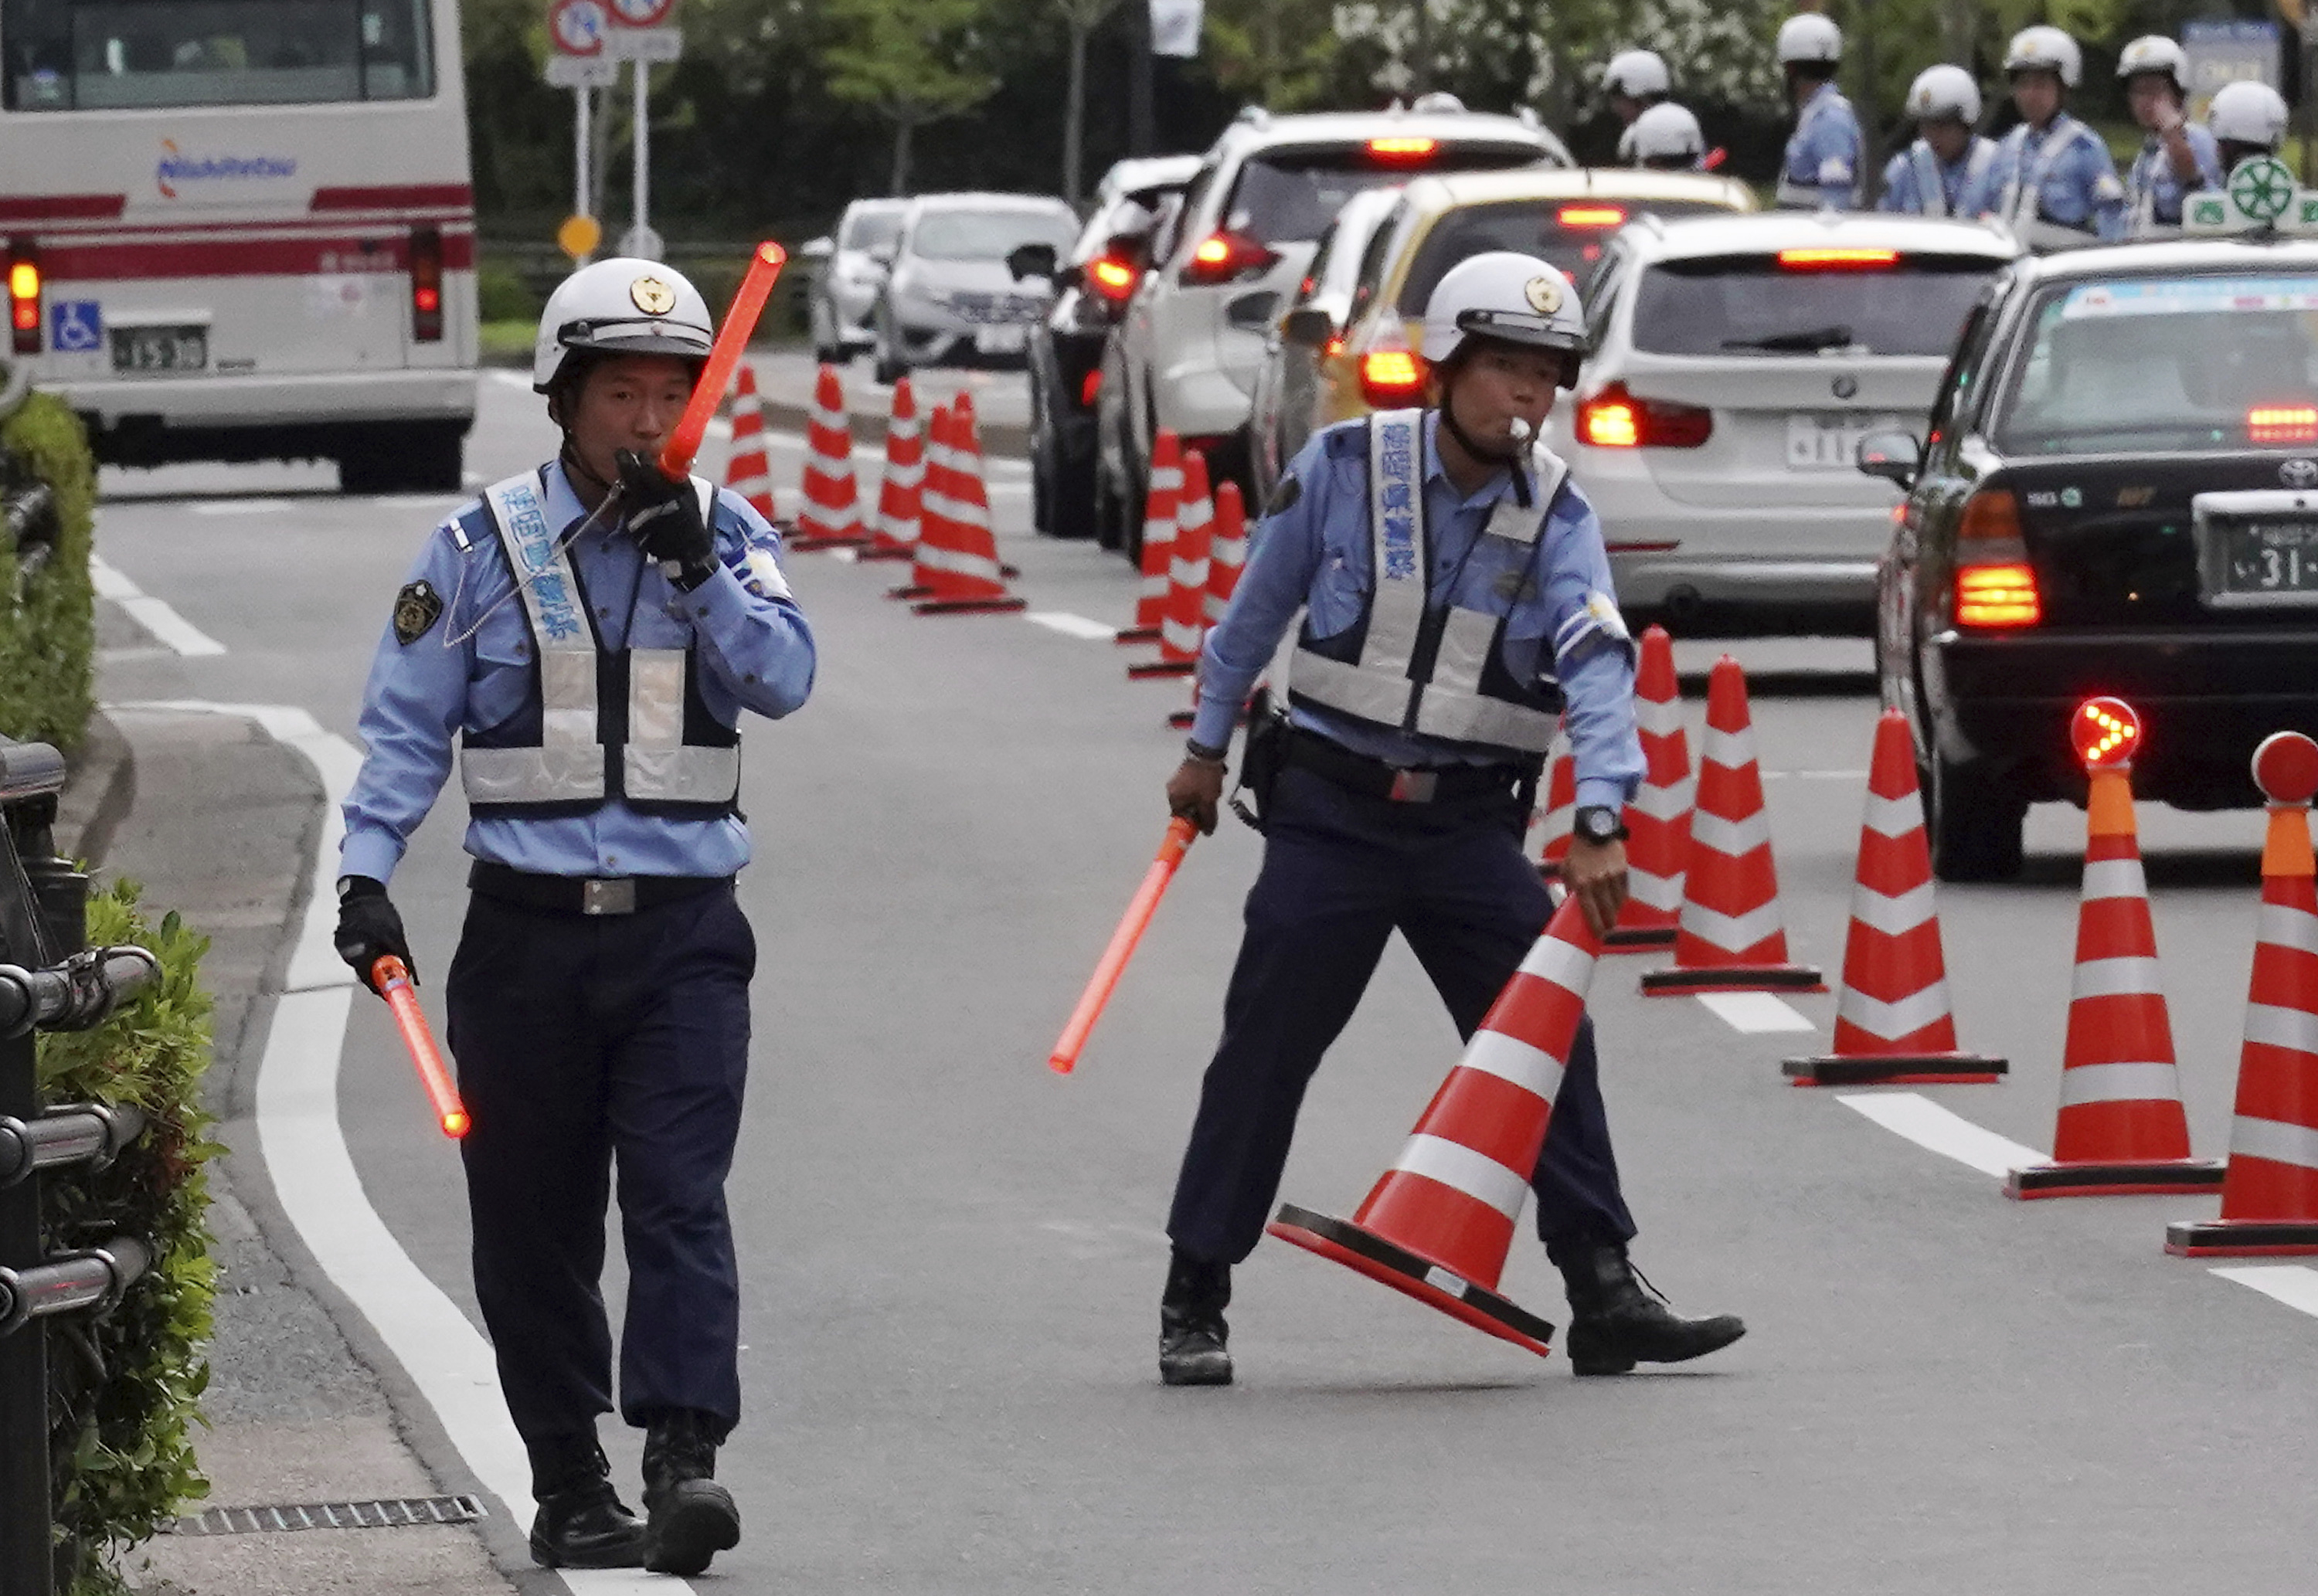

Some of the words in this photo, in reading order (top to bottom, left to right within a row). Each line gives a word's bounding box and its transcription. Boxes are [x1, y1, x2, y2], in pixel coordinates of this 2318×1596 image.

[498, 484, 580, 640] 福岡県警察
